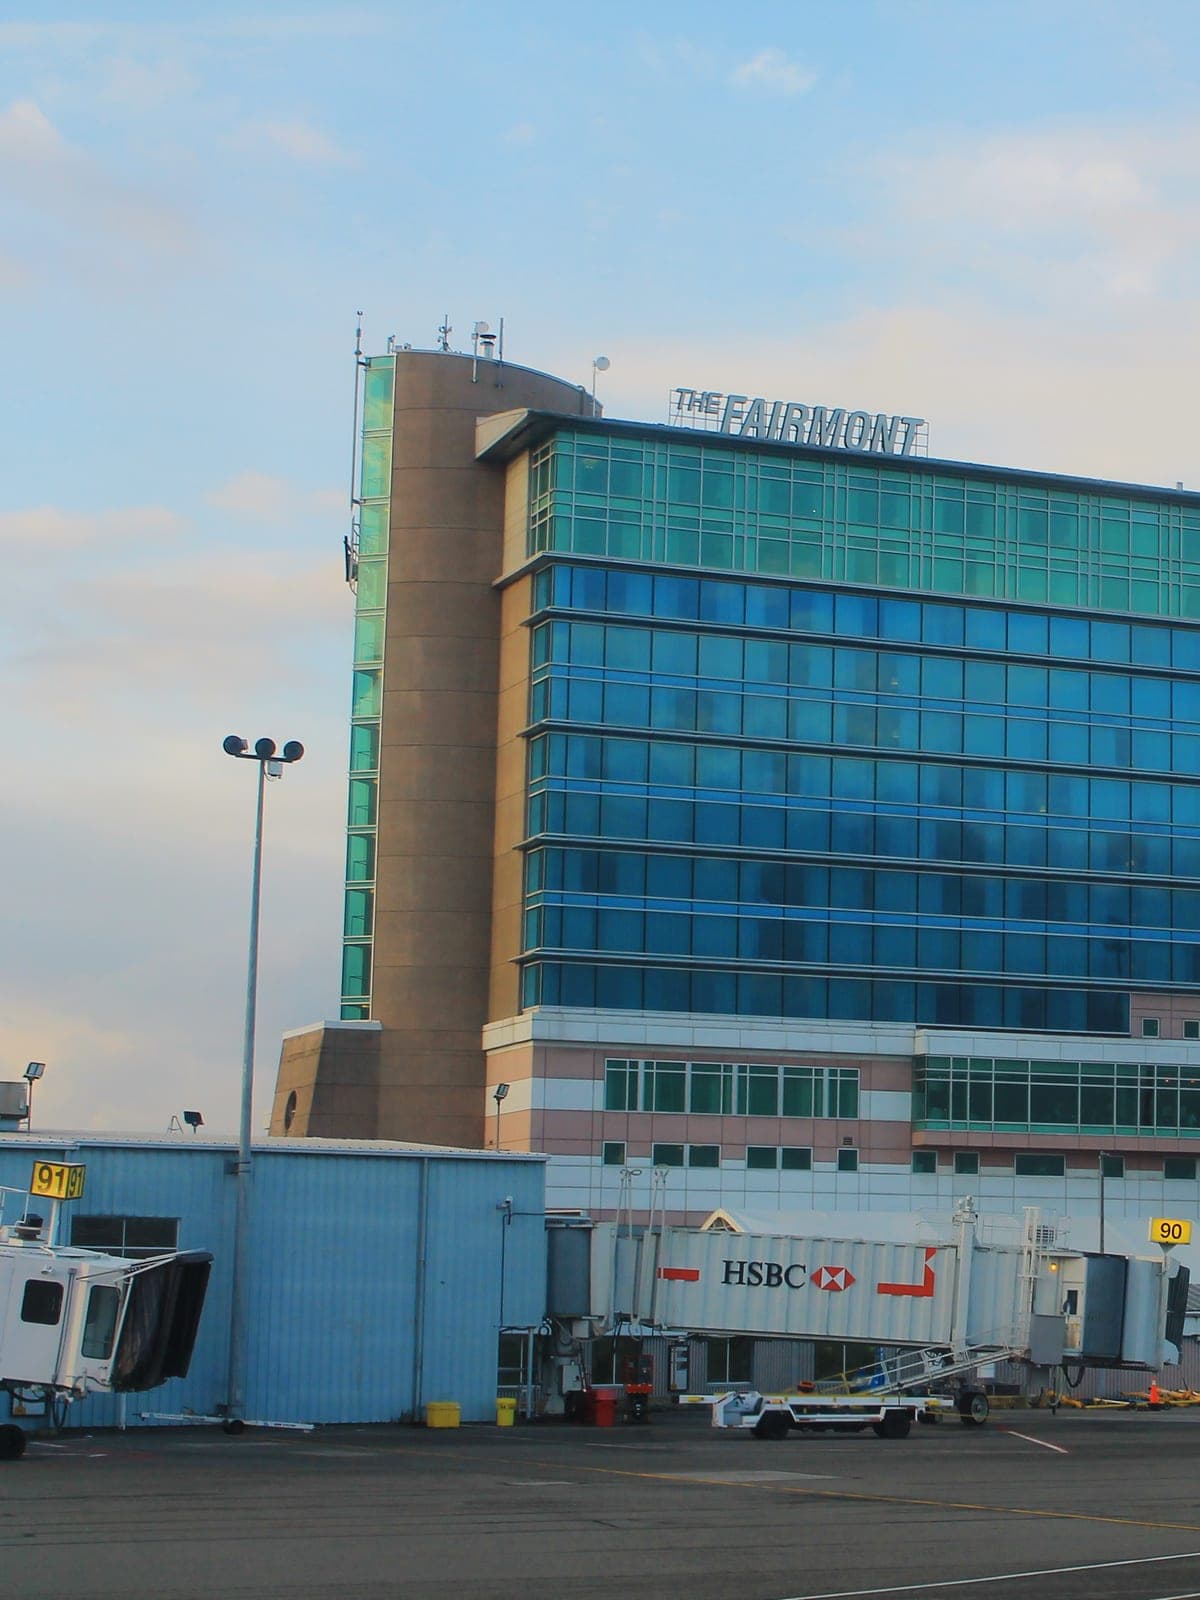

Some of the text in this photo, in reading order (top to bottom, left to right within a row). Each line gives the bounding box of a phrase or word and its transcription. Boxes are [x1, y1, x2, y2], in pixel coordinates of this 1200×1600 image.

[676, 388, 924, 456] THE FAIRMONT
[37, 1165, 65, 1195] 91
[69, 1167, 83, 1196] 91
[1160, 1222, 1182, 1240] 90
[721, 1259, 806, 1289] HSBC
